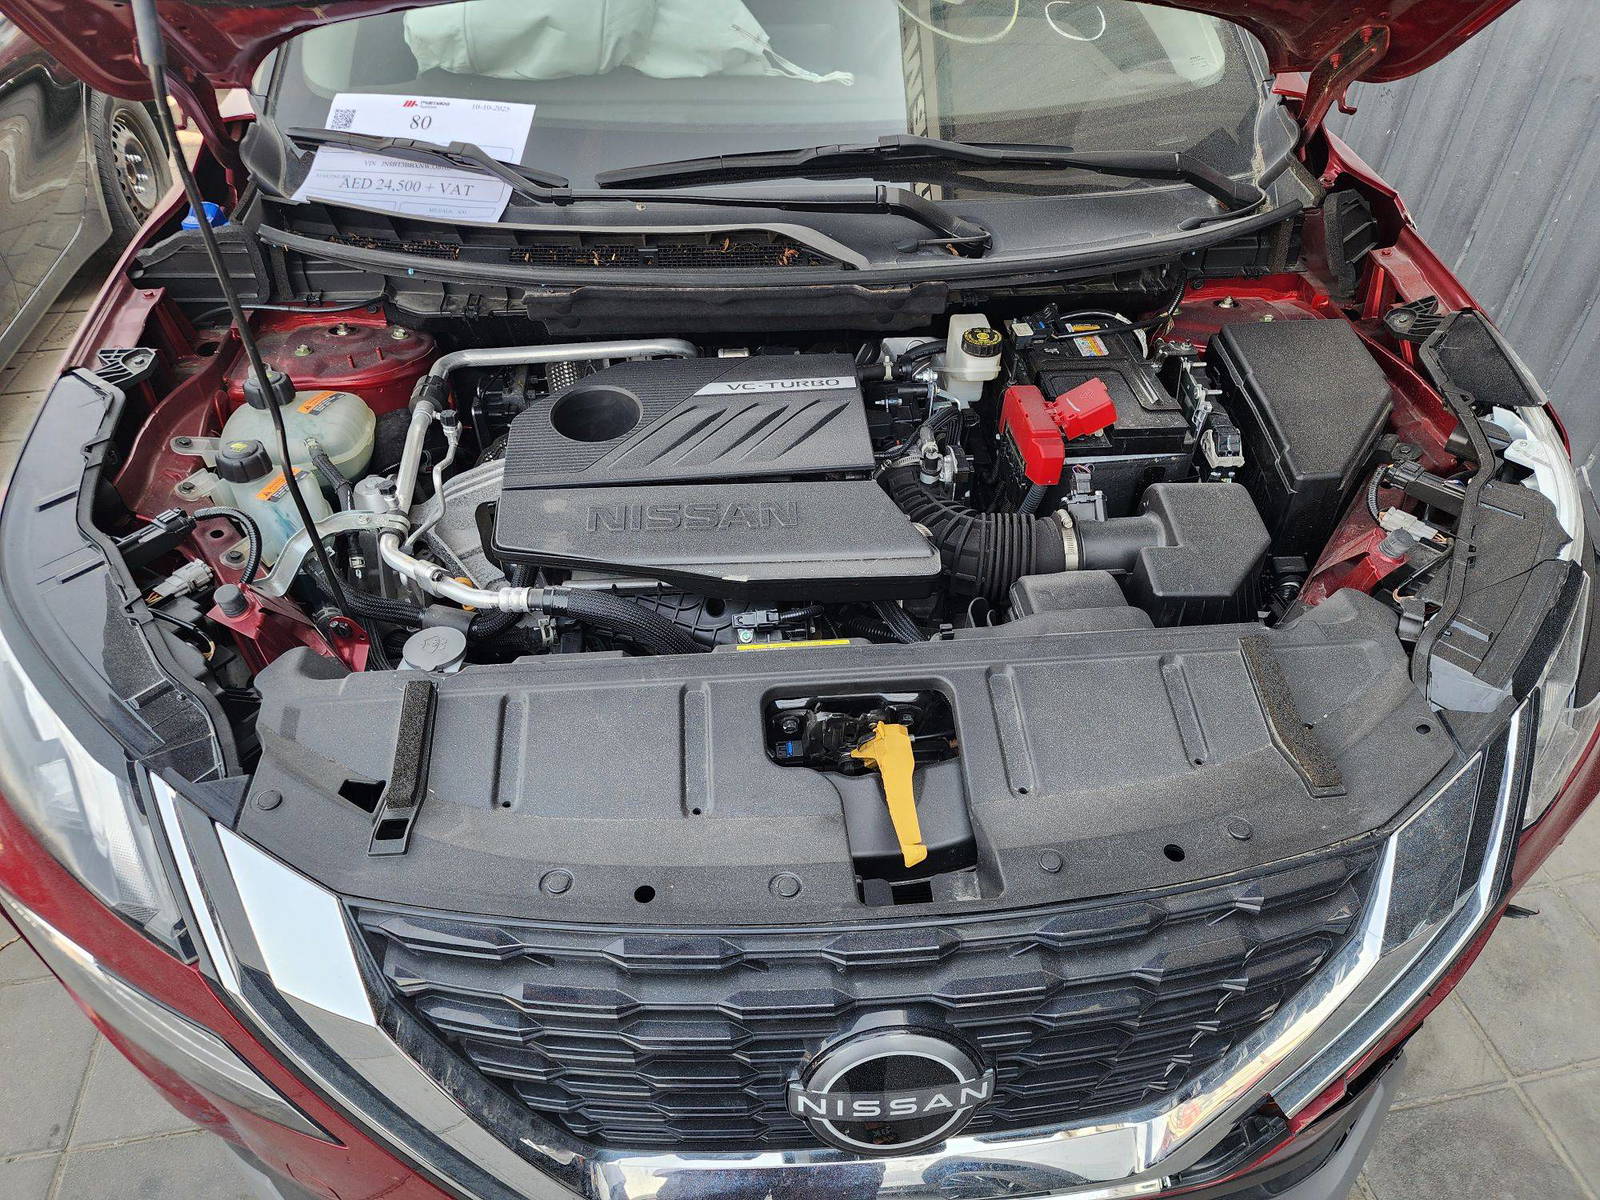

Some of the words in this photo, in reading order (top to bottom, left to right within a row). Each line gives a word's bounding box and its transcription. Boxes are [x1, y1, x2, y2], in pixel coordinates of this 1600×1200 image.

[409, 114, 432, 130] 80
[338, 177, 373, 190] AED
[375, 178, 422, 193] 24,500
[440, 182, 475, 196] VAT
[727, 379, 840, 391] VC-TURBO
[585, 501, 799, 532] NISSAN
[797, 1081, 988, 1117] NISSAN
